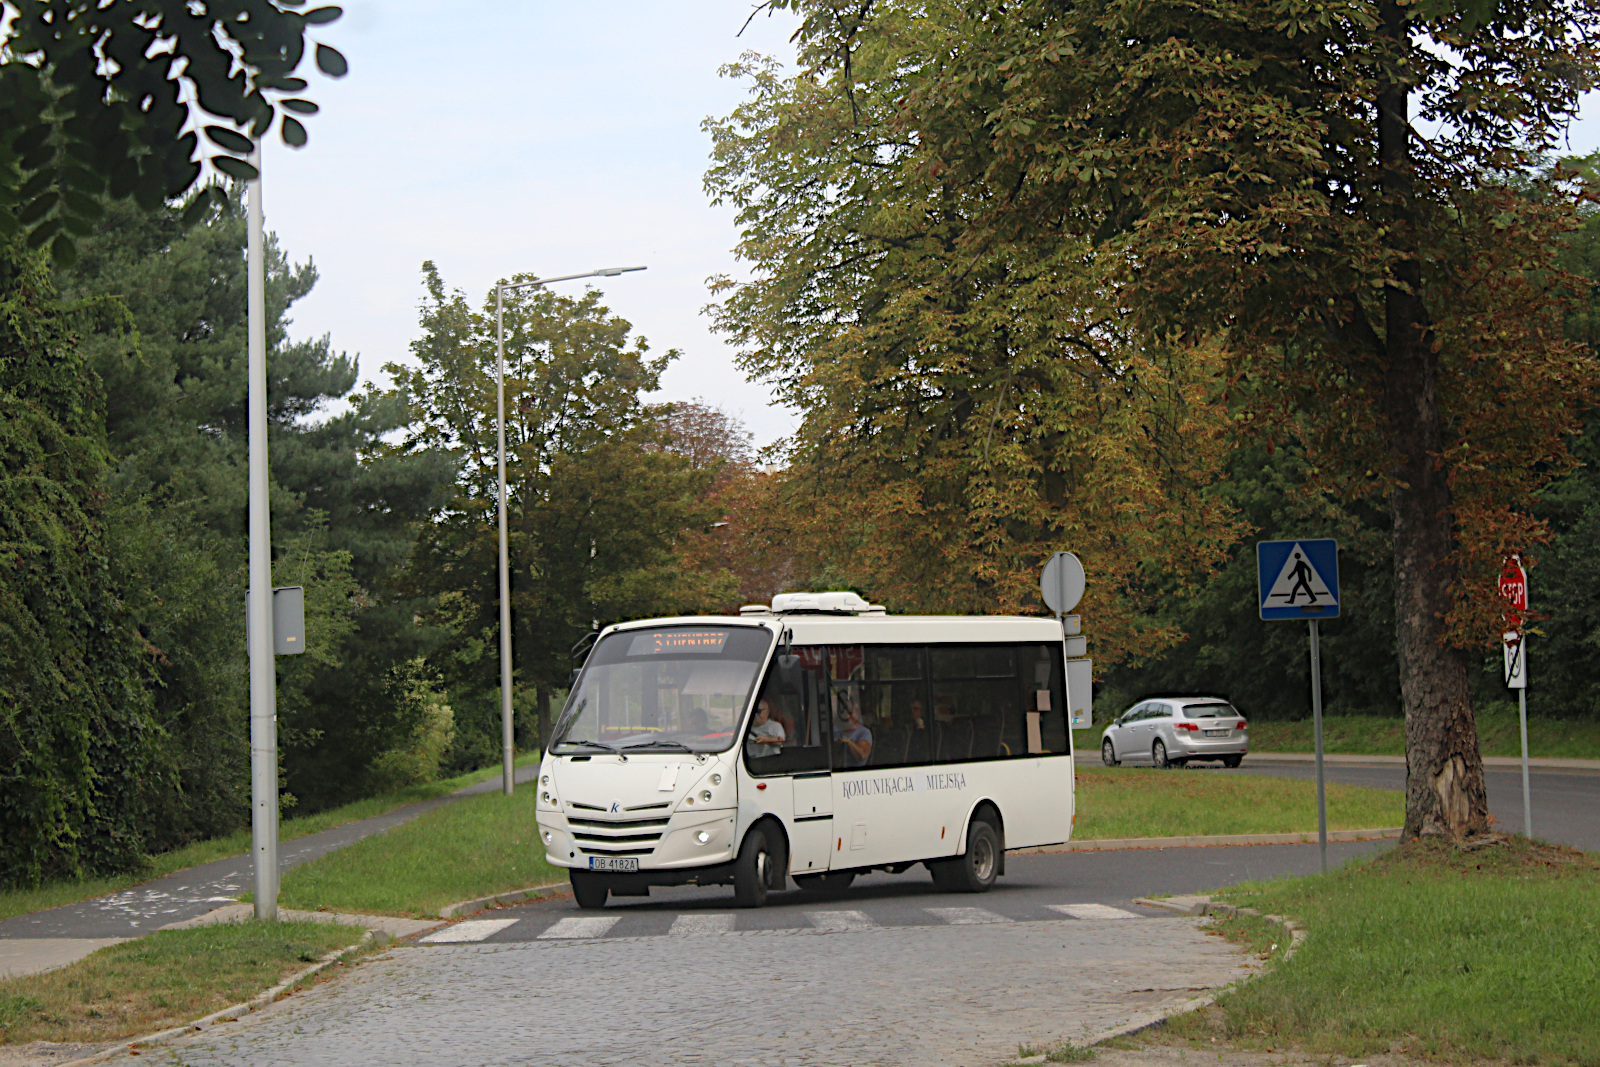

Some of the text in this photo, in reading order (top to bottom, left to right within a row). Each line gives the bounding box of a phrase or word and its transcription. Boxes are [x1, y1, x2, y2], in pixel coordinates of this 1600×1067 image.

[842, 773, 967, 800] KOMUNIKACJA MIEJSKA
[594, 858, 635, 870] OB 4182A
